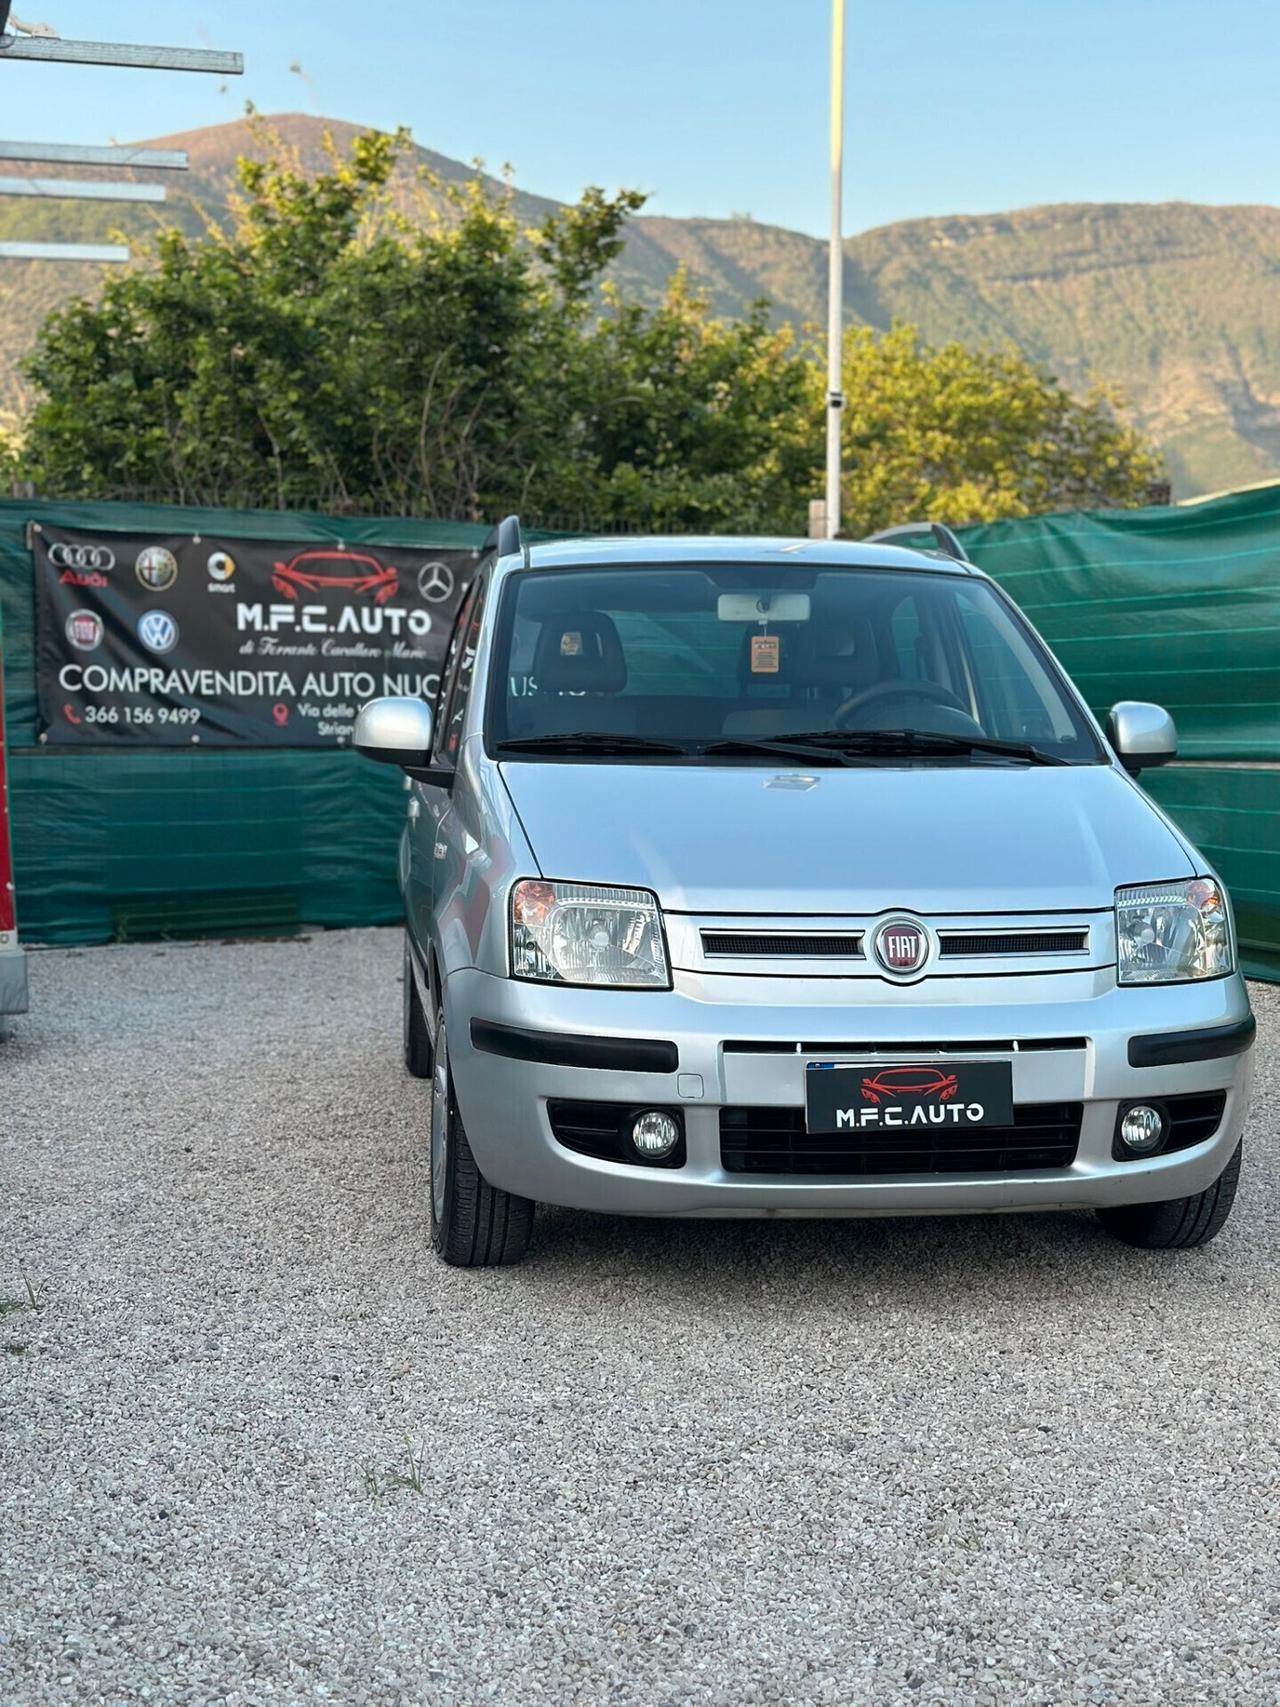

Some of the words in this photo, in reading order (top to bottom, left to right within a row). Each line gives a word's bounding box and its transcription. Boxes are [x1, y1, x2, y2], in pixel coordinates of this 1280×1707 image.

[59, 570, 108, 587] Audi
[236, 603, 432, 635] M.F.C.AUTO
[58, 664, 297, 696] COMPRAVENDITA
[301, 672, 376, 697] AUTO
[85, 705, 119, 723] 366
[123, 706, 154, 724] 156
[157, 708, 201, 724] 9499
[296, 703, 320, 717] Via
[322, 703, 355, 718] delle
[317, 721, 354, 736] Strian
[887, 935, 918, 958] FIAT
[835, 1103, 985, 1128] M.F.C.AUTO
